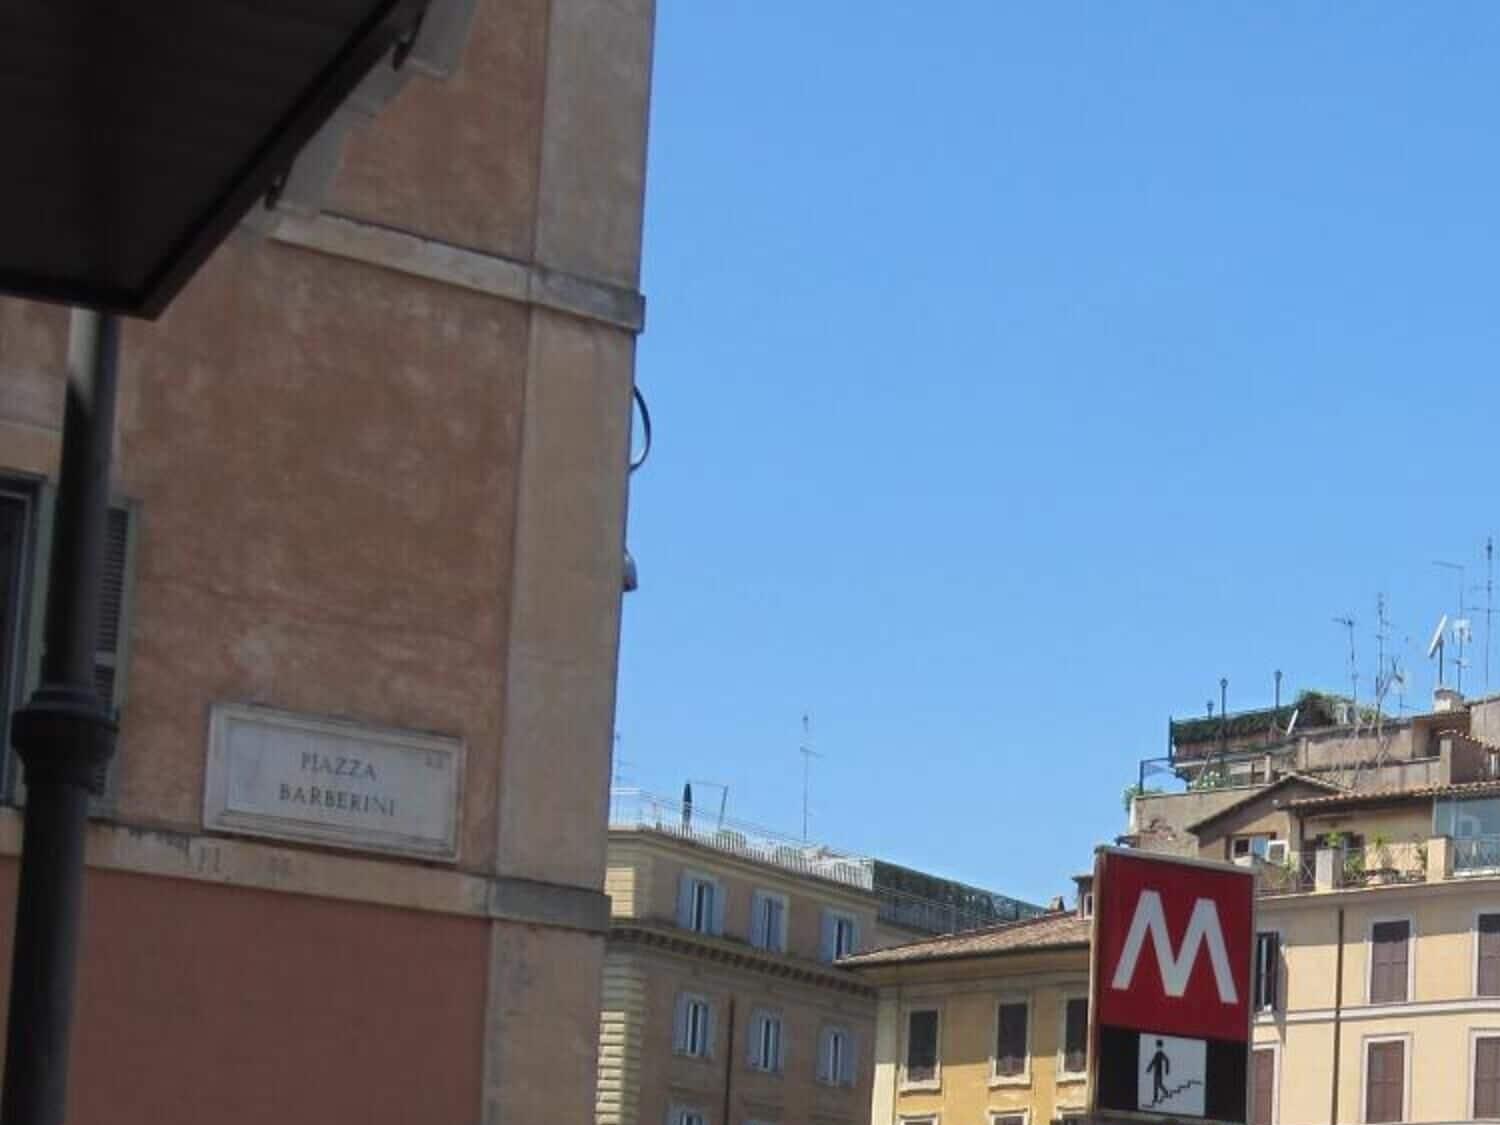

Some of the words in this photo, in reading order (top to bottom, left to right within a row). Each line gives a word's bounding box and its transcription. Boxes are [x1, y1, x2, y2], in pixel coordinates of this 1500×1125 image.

[301, 752, 377, 782] PIAZZA
[279, 783, 395, 817] BARBERINI
[1110, 889, 1238, 1005] M
